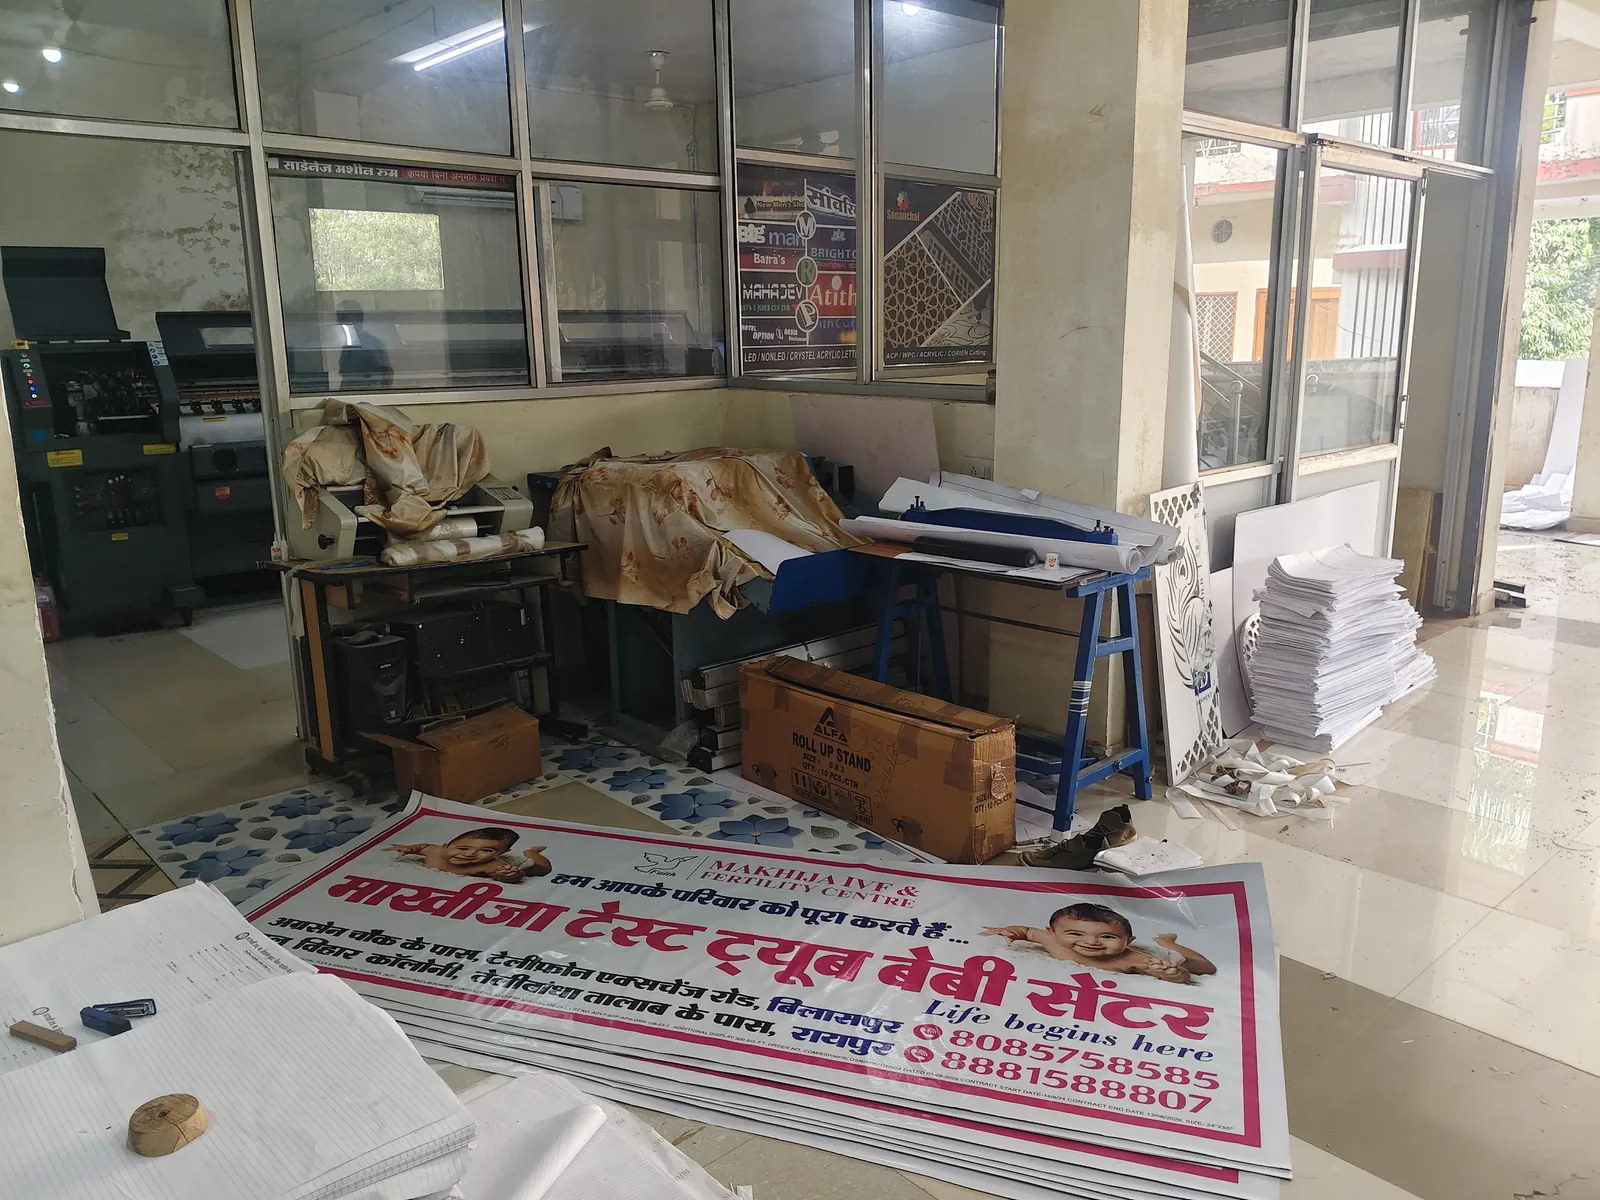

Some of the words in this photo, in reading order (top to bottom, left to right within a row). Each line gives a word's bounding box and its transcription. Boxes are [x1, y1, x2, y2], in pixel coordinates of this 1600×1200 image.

[738, 223, 766, 244] Big
[753, 253, 786, 265] Batra's
[742, 283, 803, 300] MAHADEV
[752, 331, 774, 340] OPTION
[902, 351, 916, 359] WPC
[919, 350, 944, 358] ACRYLIC
[744, 353, 757, 362] LED
[761, 351, 786, 361] NONLED
[790, 350, 816, 360] CRYSTEL
[816, 349, 841, 359] ACRYLIC
[813, 723, 848, 743] ALFA
[792, 732, 817, 754] ROLL
[820, 741, 833, 758] UP
[836, 748, 871, 773] STAND
[802, 752, 816, 763] SIZE
[700, 871, 820, 894] FERTILITY
[821, 886, 917, 909] CENTRE
[709, 860, 837, 886] MAKHIJA
[841, 876, 894, 893] IVF
[896, 885, 921, 898] &
[550, 873, 595, 888] हम
[592, 879, 674, 899] आपके
[671, 888, 759, 911] परिवार
[759, 900, 802, 918] को
[800, 907, 850, 926] पूरा
[850, 915, 922, 937] करते
[267, 916, 350, 938] अग्रसेन
[400, 936, 432, 951] के
[766, 996, 904, 1034] बिलासपुर
[327, 874, 571, 932] माखीजा
[564, 900, 708, 952] टेस्ट
[706, 928, 874, 987] ट्यूब
[877, 945, 1017, 1007] बेबी
[1026, 972, 1215, 1041] सेंटर
[582, 991, 672, 1017] तालाब
[674, 1003, 711, 1022] के
[791, 1025, 896, 1056] रायपुर
[921, 999, 992, 1026] Life
[1004, 1012, 1117, 1047] begins
[1131, 1034, 1215, 1063] here
[673, 1025, 708, 1035] ADDITIONAL
[767, 1042, 791, 1050] ORDER
[902, 1067, 926, 1075] DATED
[960, 1078, 998, 1088] CONTRACT
[999, 1085, 1022, 1093] START
[1067, 1098, 1107, 1109] CONTRACT
[1125, 1108, 1145, 1116] DATE
[949, 1028, 1220, 1091] 8085758585
[941, 1050, 1213, 1114] 8881588807
